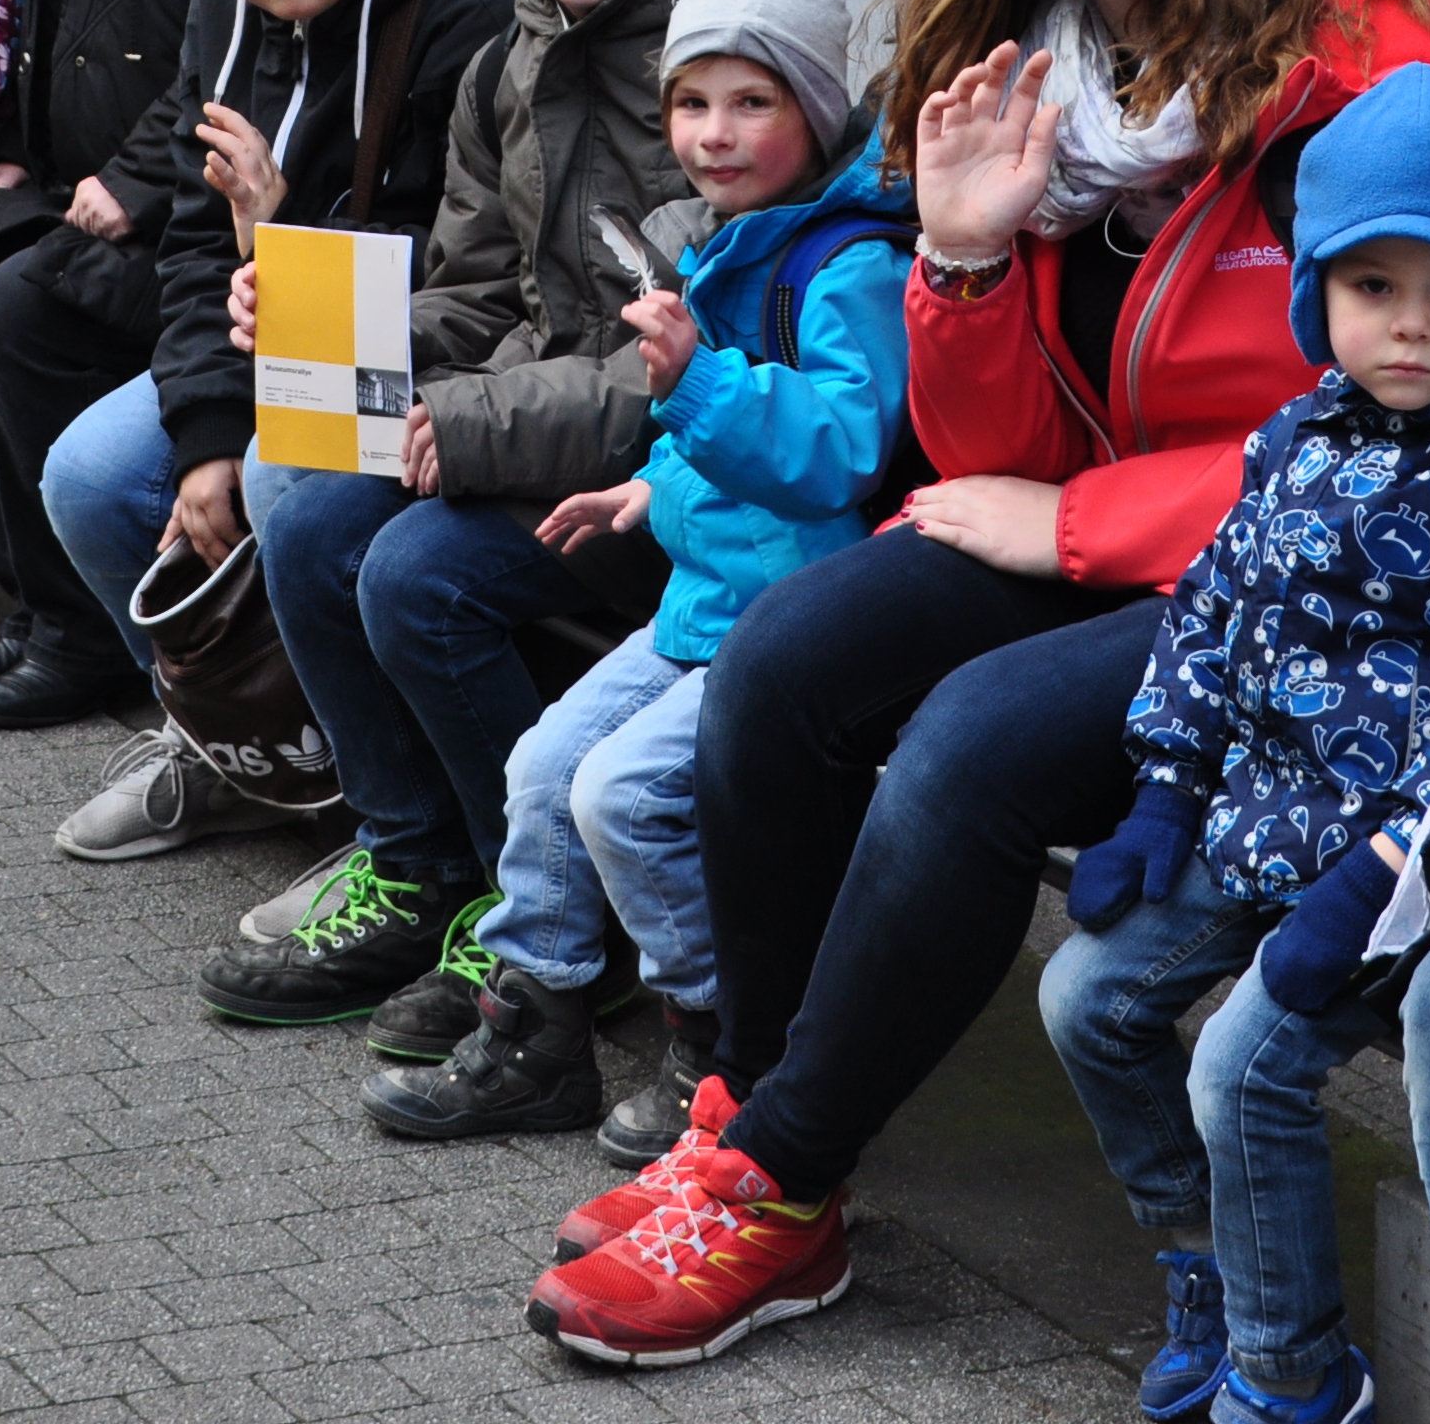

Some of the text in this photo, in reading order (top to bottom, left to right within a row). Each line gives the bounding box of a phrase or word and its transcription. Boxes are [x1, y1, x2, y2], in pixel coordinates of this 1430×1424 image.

[1215, 247, 1262, 262] REGATTA
[1215, 256, 1288, 271] GREAT OUTDOORS
